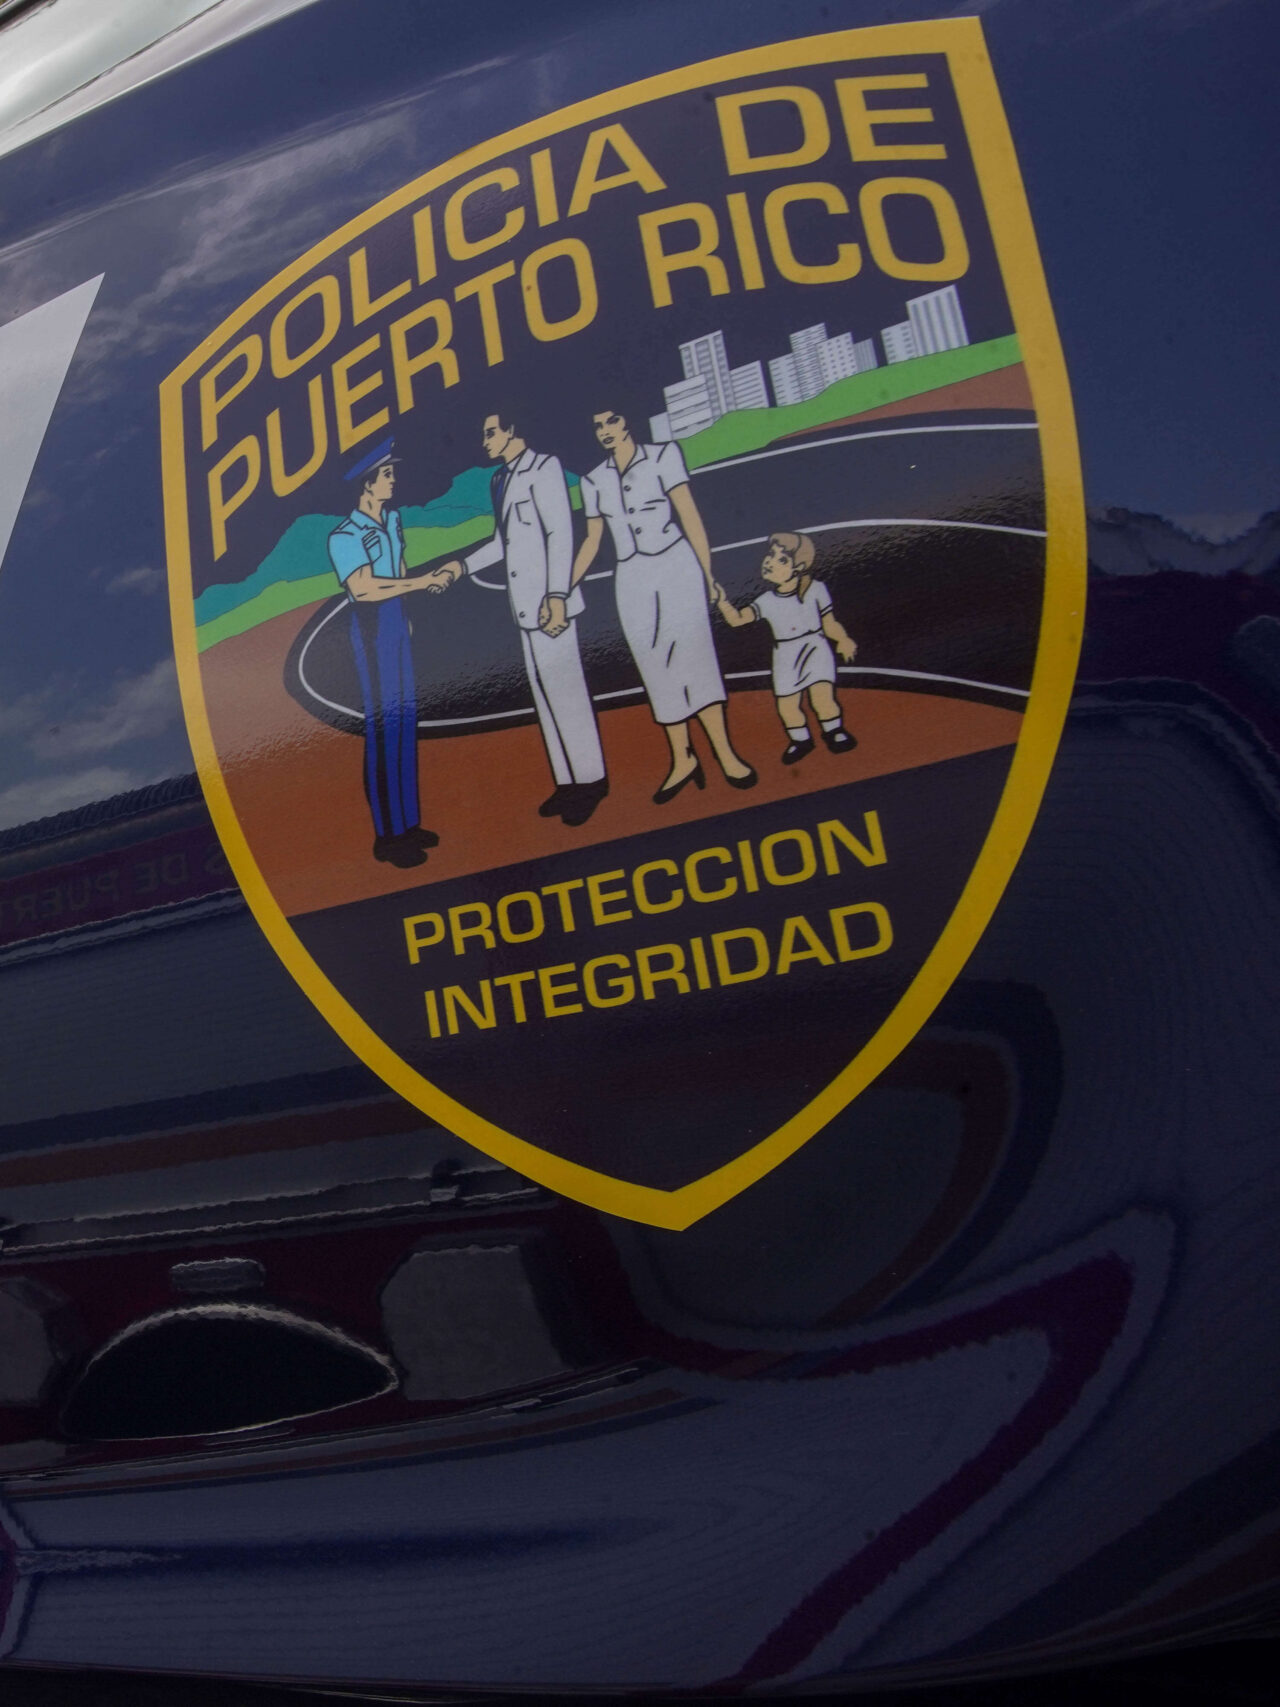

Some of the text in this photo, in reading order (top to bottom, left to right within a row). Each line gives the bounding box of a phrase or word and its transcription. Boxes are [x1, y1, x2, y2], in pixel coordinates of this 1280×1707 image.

[199, 73, 948, 451] POLICIA DE
[208, 177, 970, 561] PUERTO RICO
[402, 810, 888, 965] PROTECCION
[424, 901, 894, 1039] INTEGRIDAD
